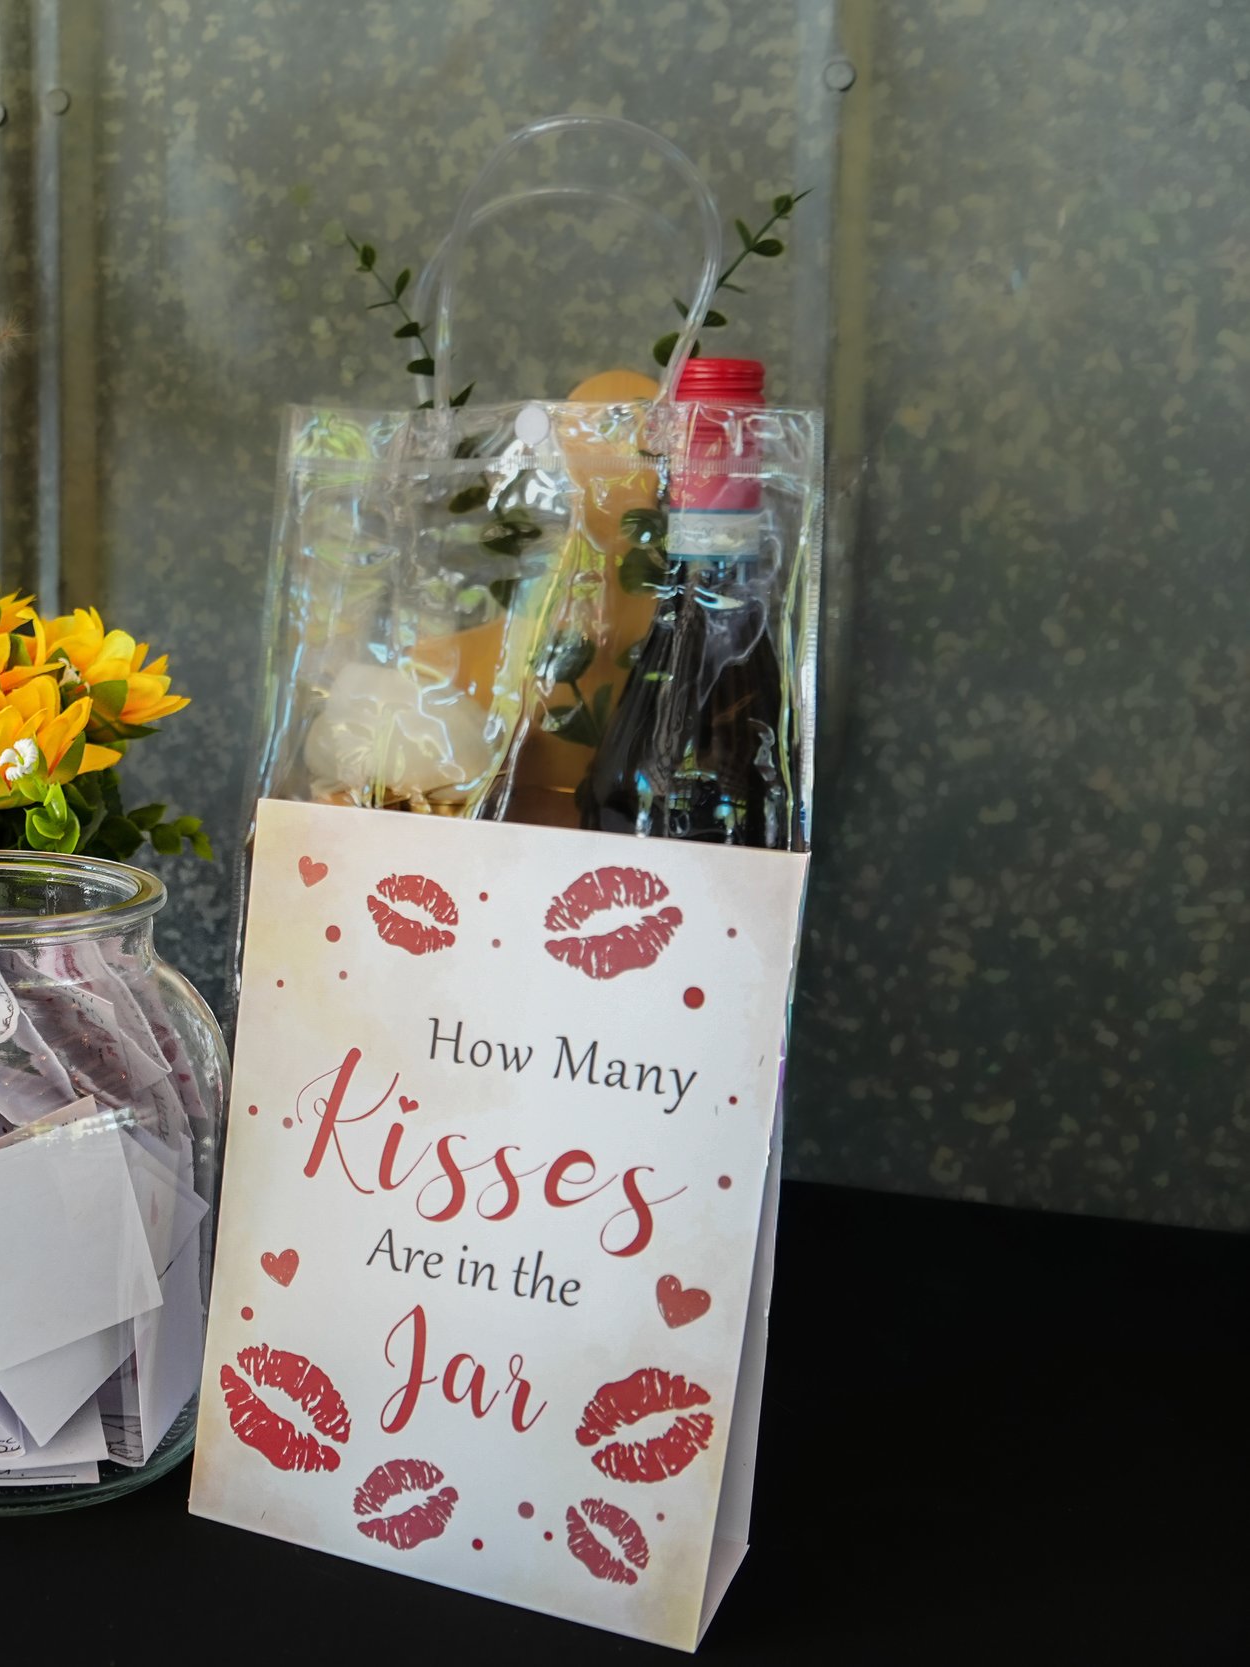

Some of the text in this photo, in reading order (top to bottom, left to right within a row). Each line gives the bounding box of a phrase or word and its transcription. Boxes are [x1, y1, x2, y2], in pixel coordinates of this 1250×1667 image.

[427, 1017, 697, 1114] How Many
[296, 1047, 688, 1258] Kisses
[366, 1228, 581, 1307] Are in the
[380, 1304, 548, 1434] Jar
